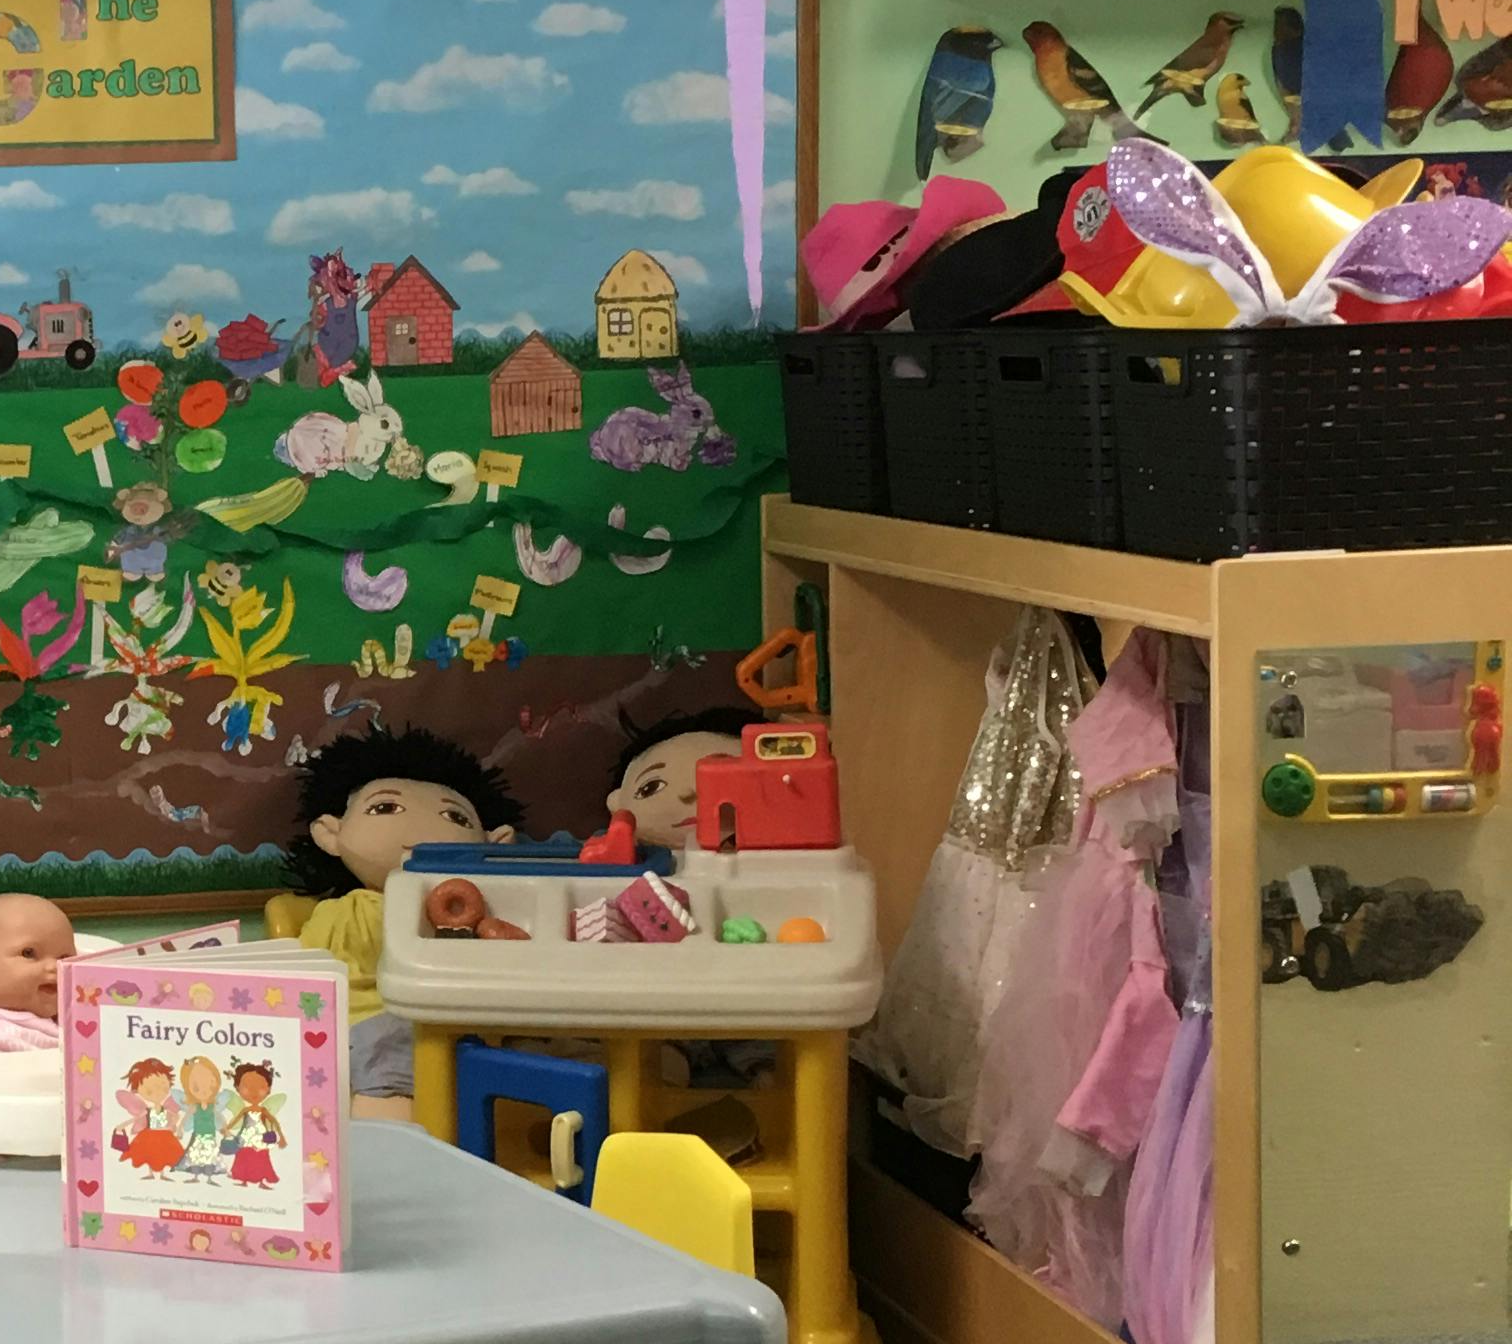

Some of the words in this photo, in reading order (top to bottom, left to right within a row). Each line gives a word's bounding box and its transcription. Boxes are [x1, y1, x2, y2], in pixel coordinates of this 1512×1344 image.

[126, 1015, 189, 1045] Fairy
[196, 1020, 275, 1049] Colors
[170, 1210, 240, 1225] SCHOLASTIC
